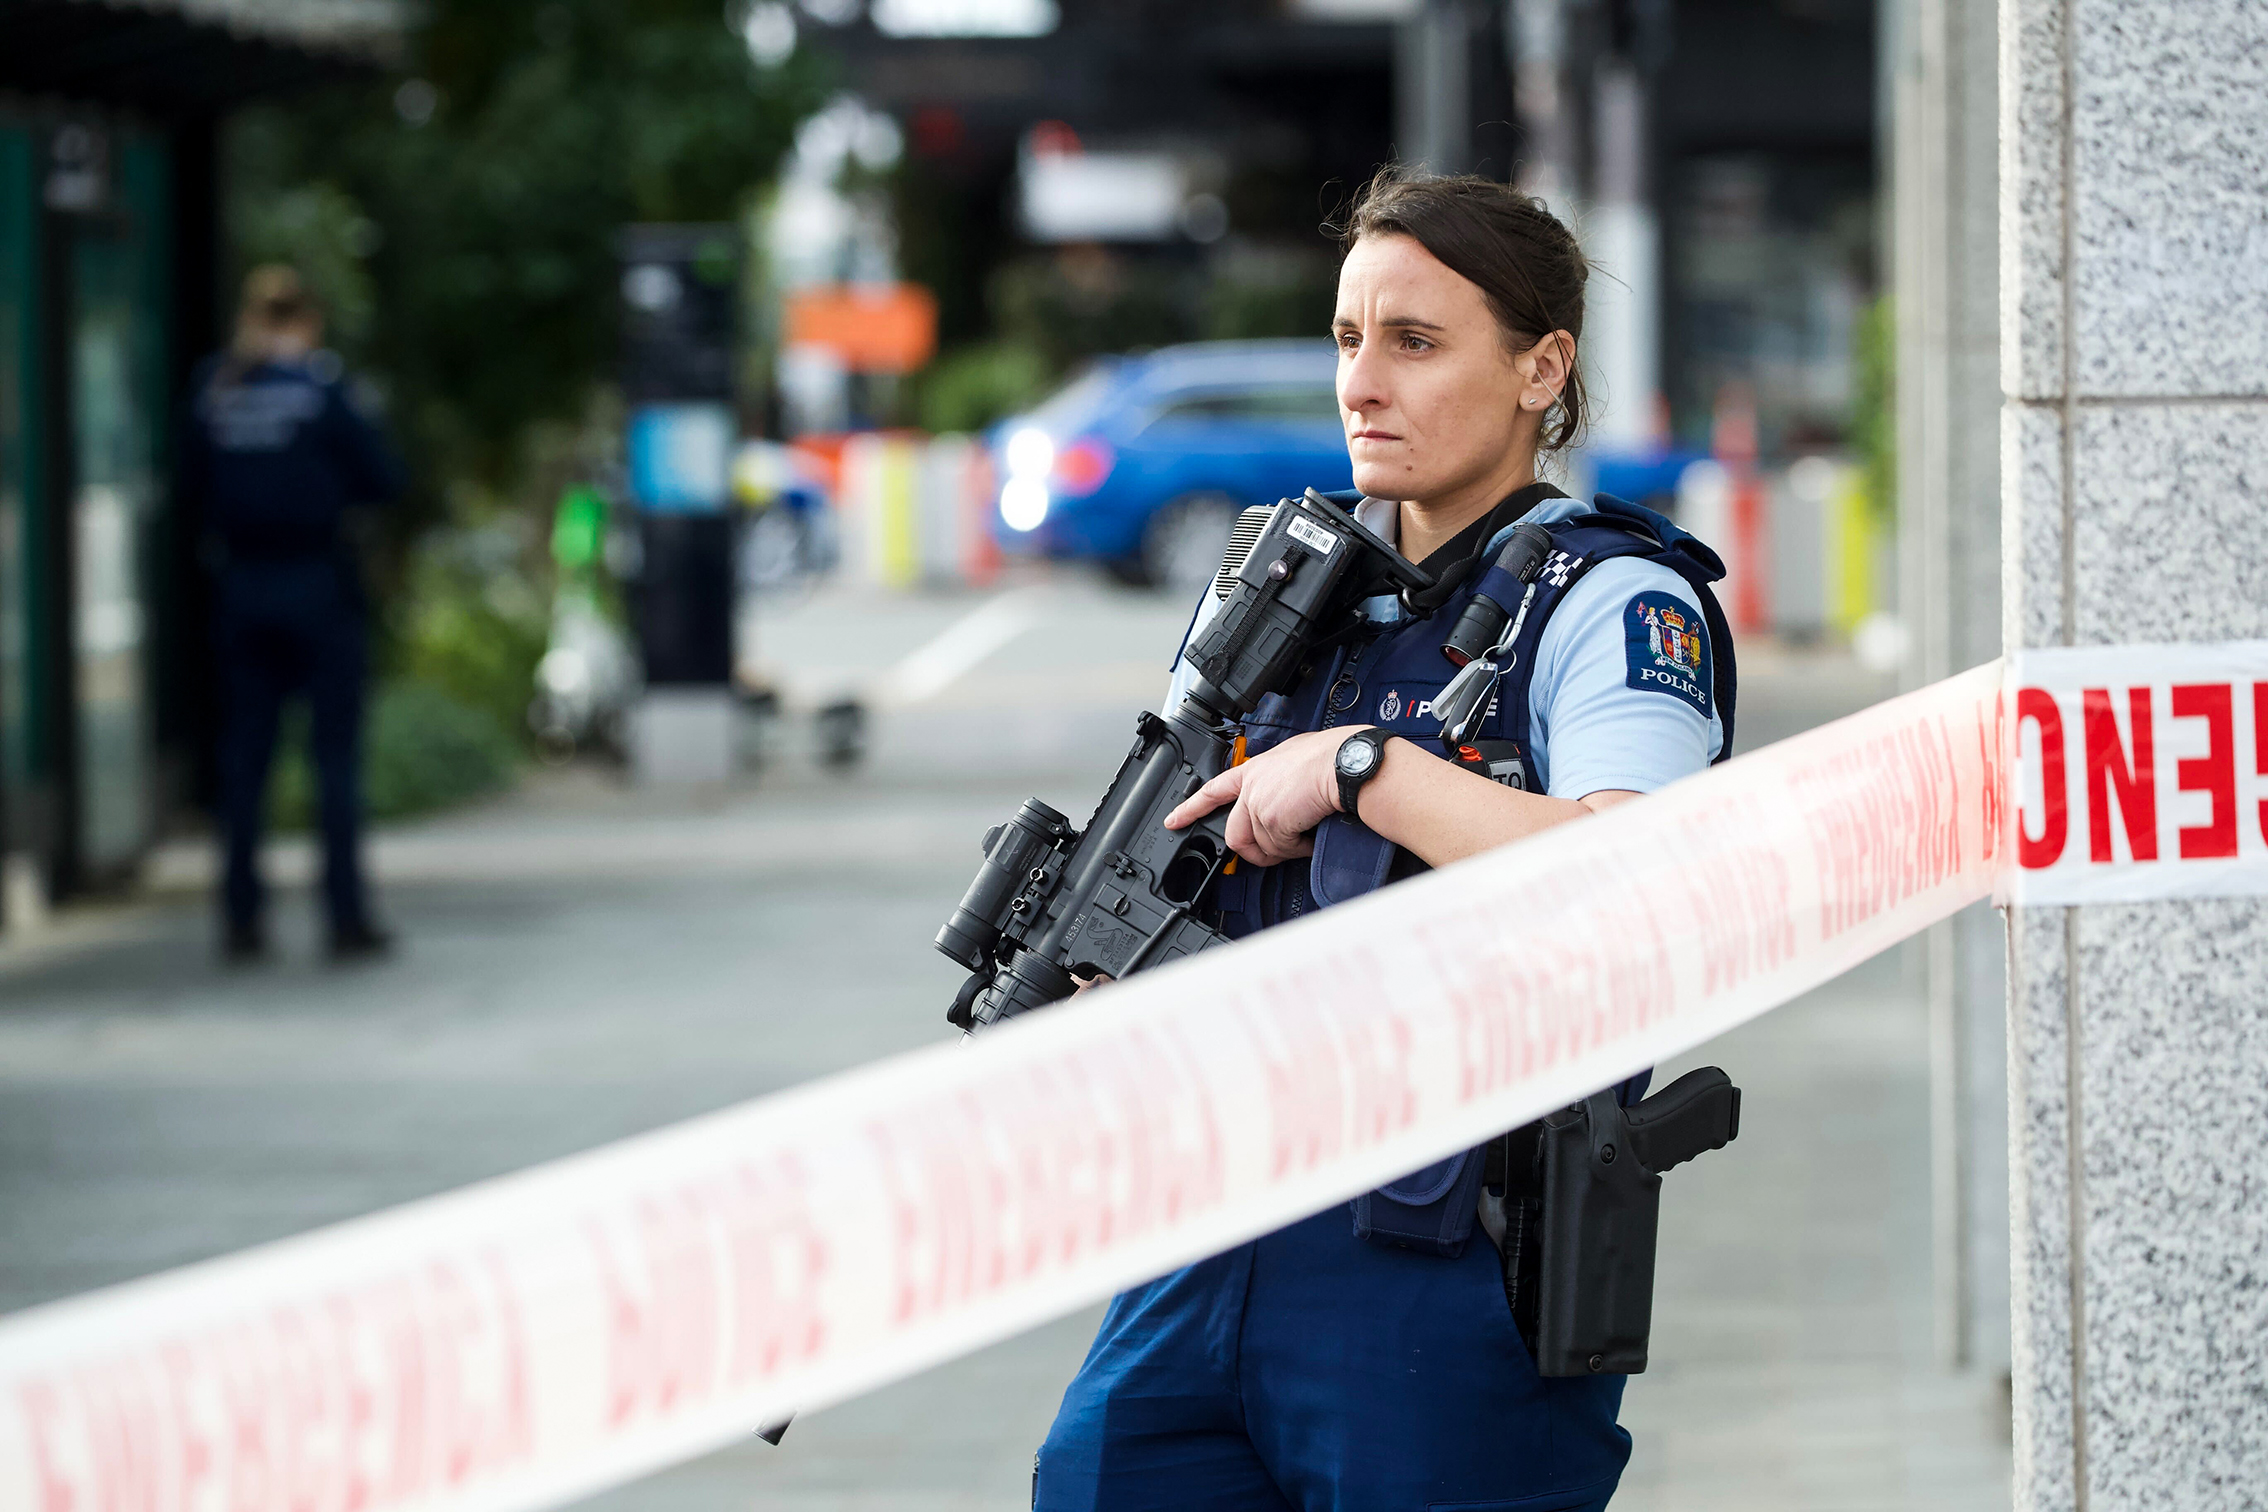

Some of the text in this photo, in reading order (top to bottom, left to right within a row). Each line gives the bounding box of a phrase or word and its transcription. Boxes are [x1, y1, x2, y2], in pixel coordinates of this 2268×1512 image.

[1640, 667, 1706, 705] POLICE
[2015, 680, 2268, 870] ENC
[1064, 913, 1087, 943] 453174
